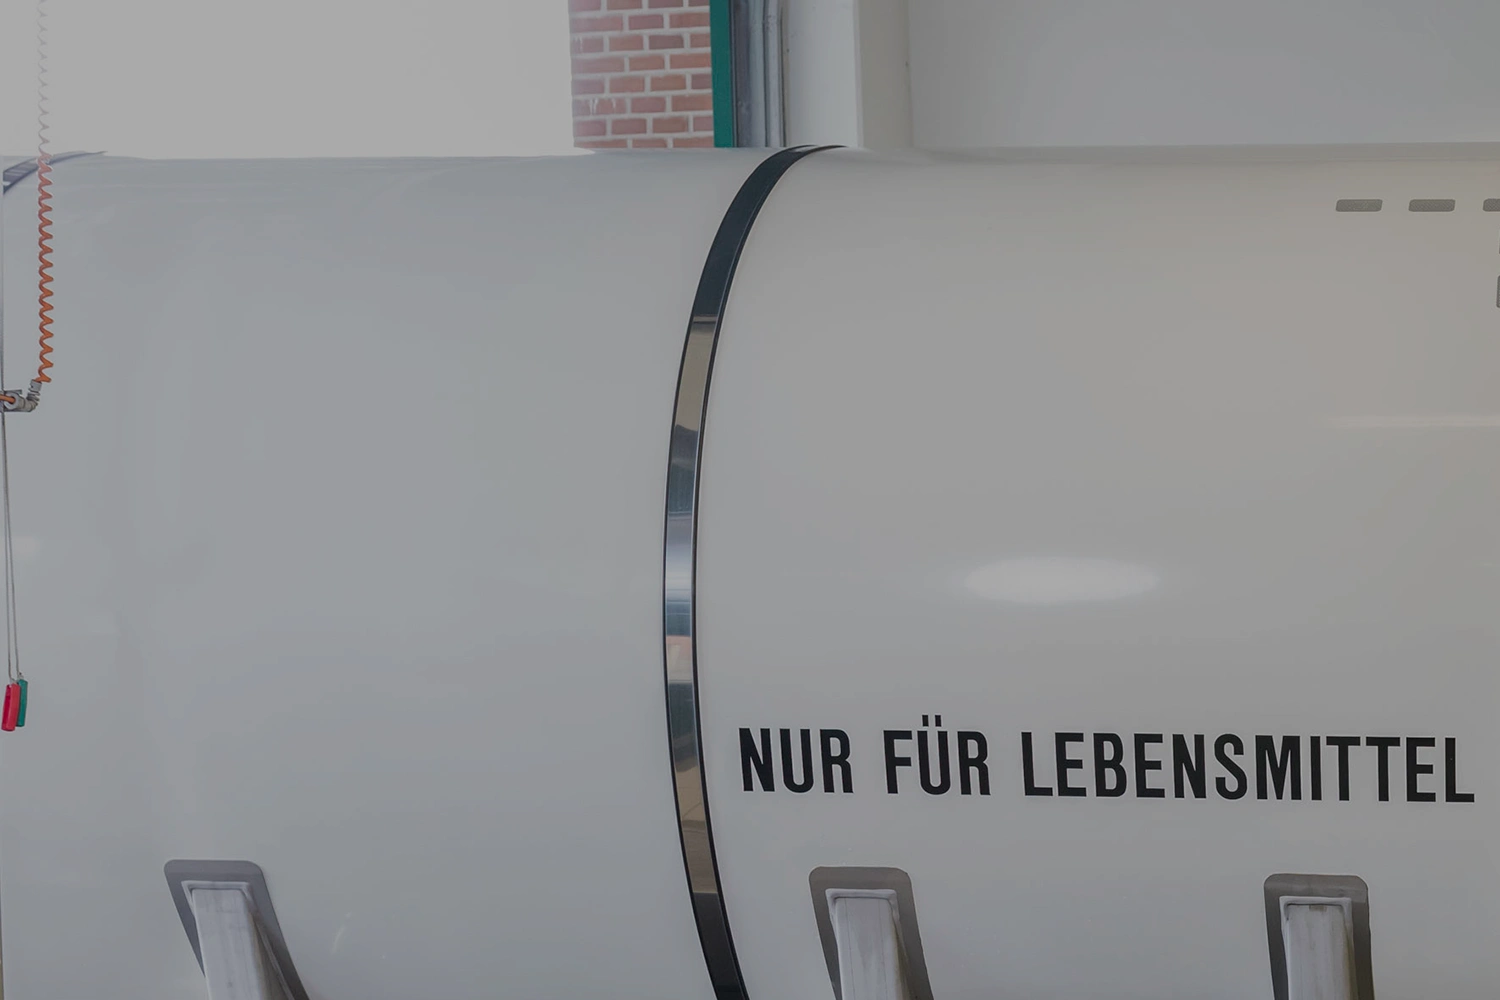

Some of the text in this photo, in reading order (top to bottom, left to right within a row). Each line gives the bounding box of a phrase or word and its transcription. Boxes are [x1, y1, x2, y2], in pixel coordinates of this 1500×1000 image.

[738, 714, 1475, 803] NUR FÜR LEBENSMITTEL
